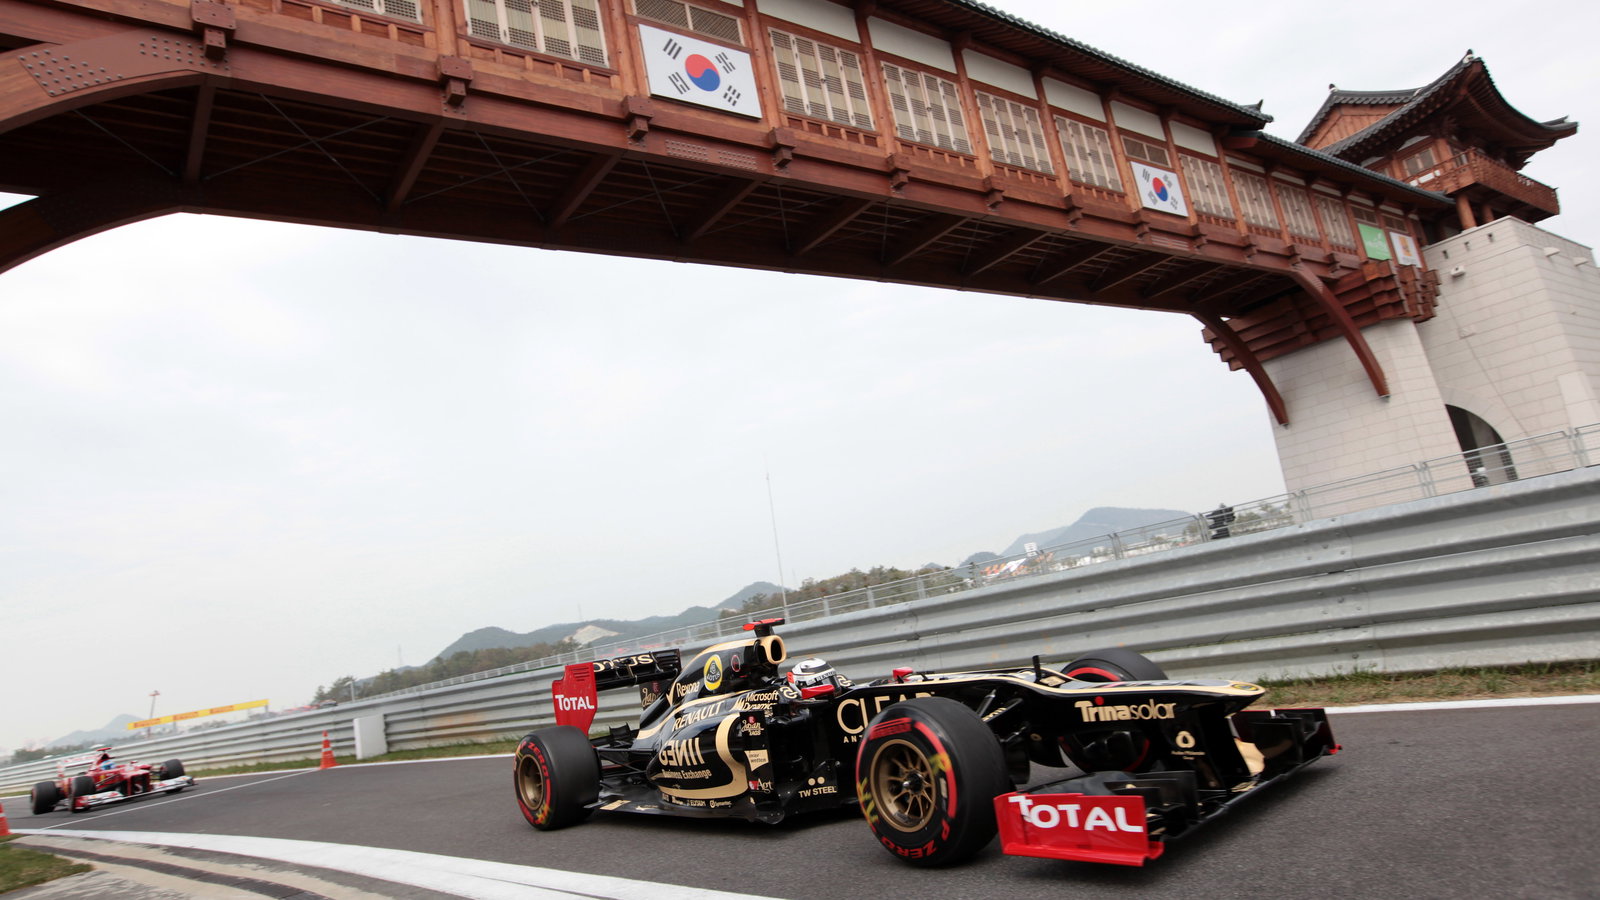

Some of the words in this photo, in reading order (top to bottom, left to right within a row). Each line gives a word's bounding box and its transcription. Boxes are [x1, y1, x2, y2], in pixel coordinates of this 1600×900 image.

[676, 681, 700, 697] Rexona
[745, 689, 779, 702] Microsoft
[554, 694, 595, 711] TOTAL
[671, 700, 726, 732] RENAULT
[681, 768, 712, 780] Exchange
[798, 789, 812, 798] TW
[813, 786, 837, 796] STEEL
[1008, 795, 1144, 833] TOTAL
[881, 836, 937, 859] ZERO
